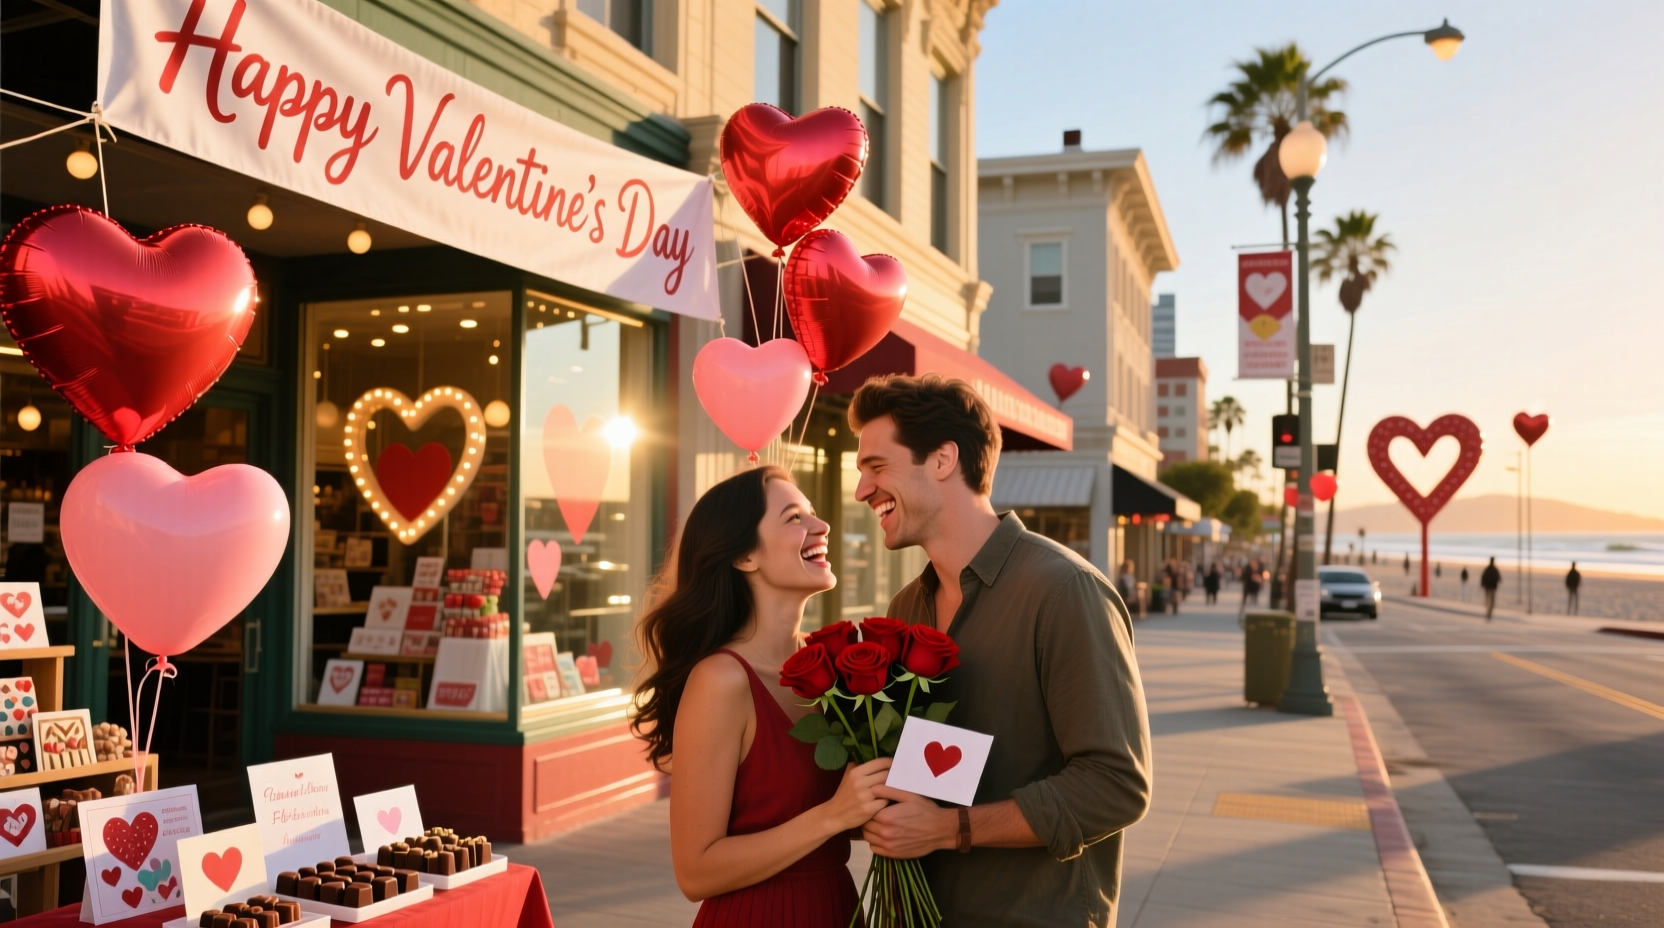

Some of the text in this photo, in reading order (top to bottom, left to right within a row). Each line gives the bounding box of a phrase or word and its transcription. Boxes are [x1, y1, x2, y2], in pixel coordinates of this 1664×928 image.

[155, 0, 695, 296] Happy Valentine's Day
